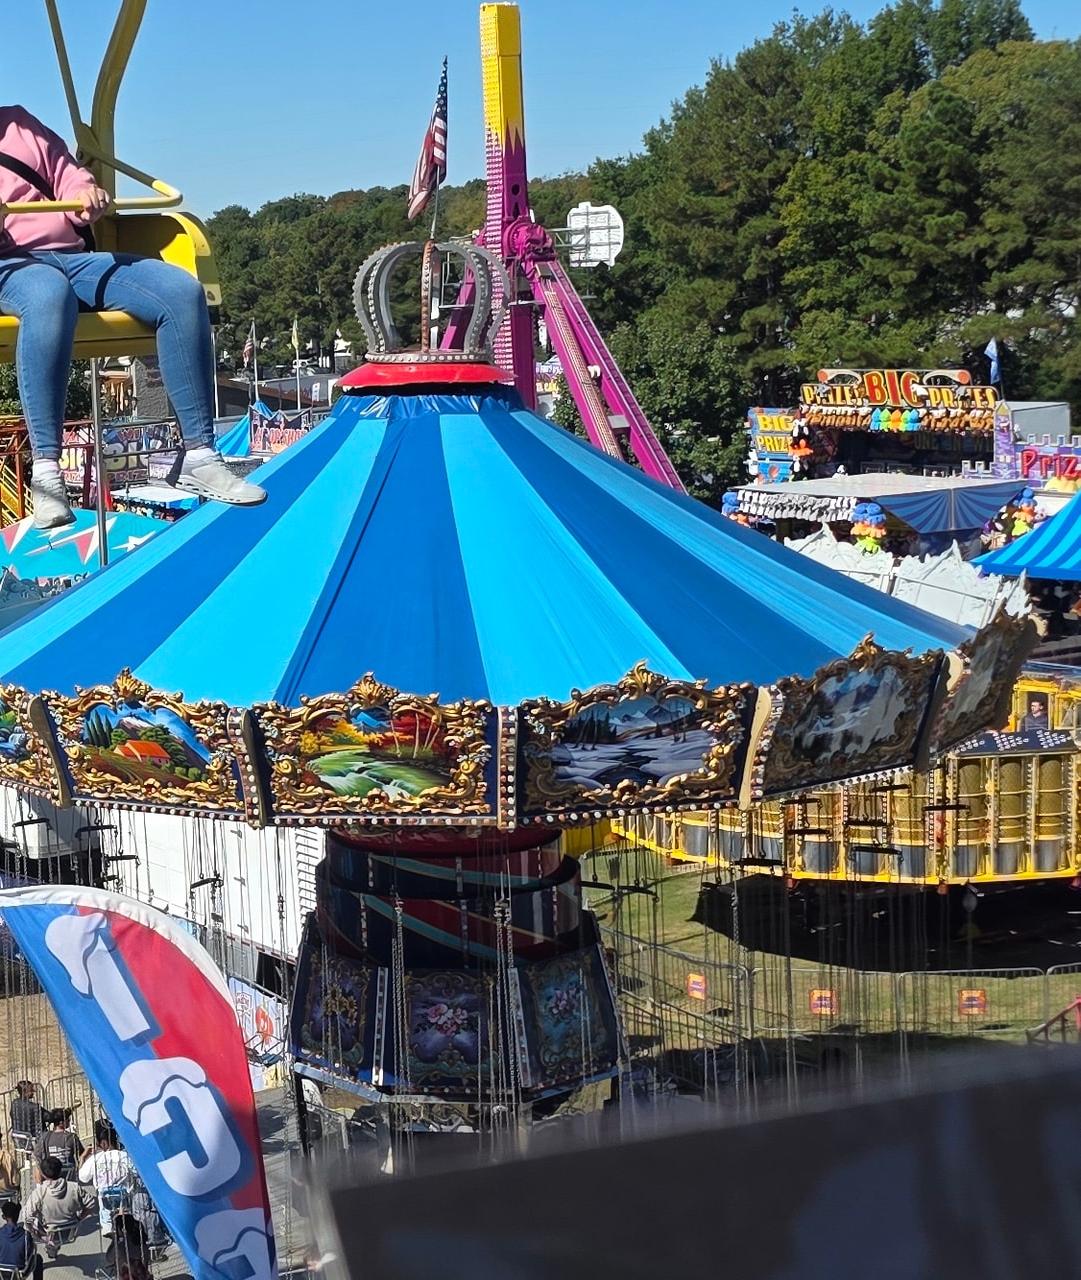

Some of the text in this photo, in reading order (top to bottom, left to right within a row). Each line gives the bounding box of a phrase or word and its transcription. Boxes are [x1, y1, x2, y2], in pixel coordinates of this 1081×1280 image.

[863, 370, 922, 408] BIG
[928, 388, 996, 409] PRES
[757, 414, 794, 432] BIG
